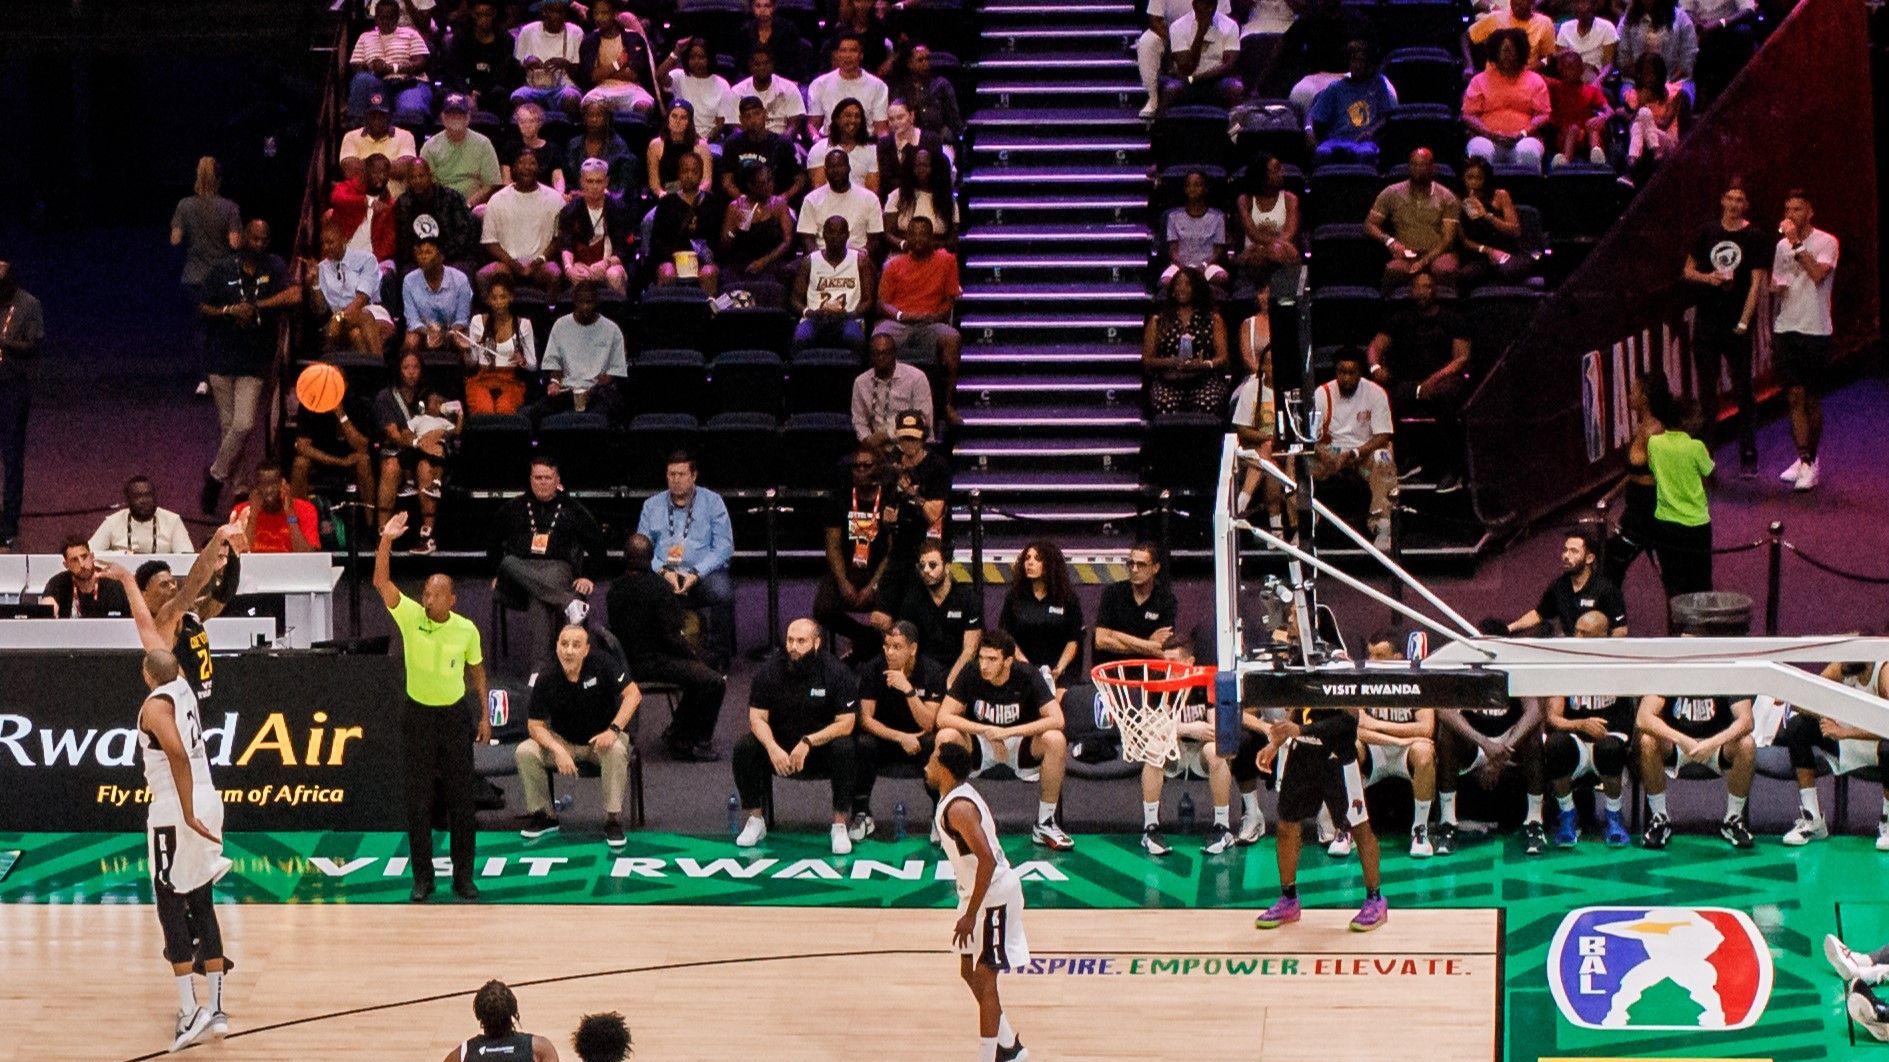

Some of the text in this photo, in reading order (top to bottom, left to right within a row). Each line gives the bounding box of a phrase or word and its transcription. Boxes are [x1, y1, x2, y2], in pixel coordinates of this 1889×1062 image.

[816, 277, 857, 291] LAKERS
[1322, 683, 1421, 696] VISIT RWANDA
[97, 785, 131, 806] Fly
[134, 786, 155, 803] th
[247, 785, 272, 807] of
[274, 784, 345, 807] Africa
[1003, 957, 1473, 976] SPIRE. EMPOWER. ELEVATE.
[1578, 936, 1608, 995] BAL
